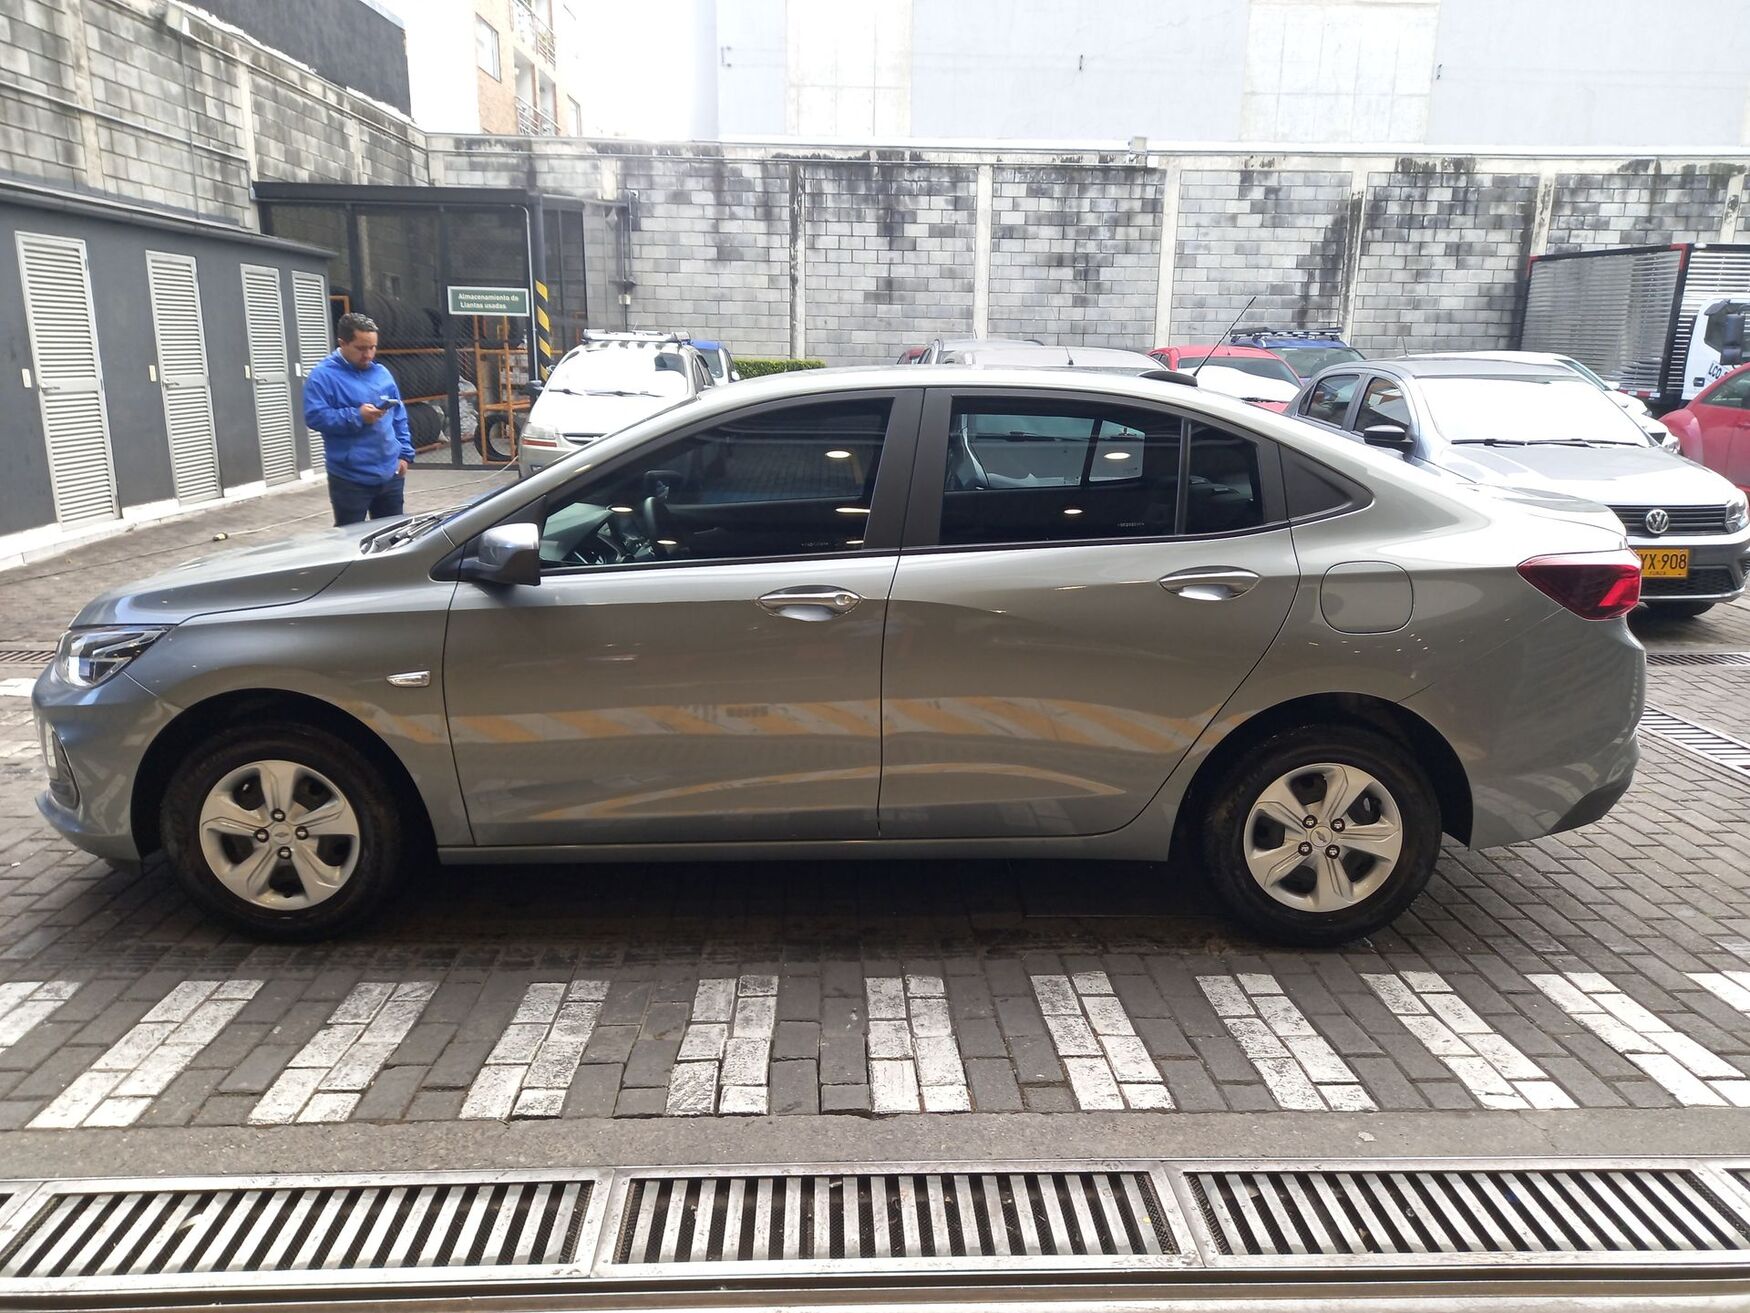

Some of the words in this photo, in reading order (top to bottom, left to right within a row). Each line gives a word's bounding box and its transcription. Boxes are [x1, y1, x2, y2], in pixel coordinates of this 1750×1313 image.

[458, 293, 510, 301] Almacenamiento
[460, 301, 483, 309] Llantas
[484, 302, 507, 310] usadas
[1637, 553, 1657, 570] YX
